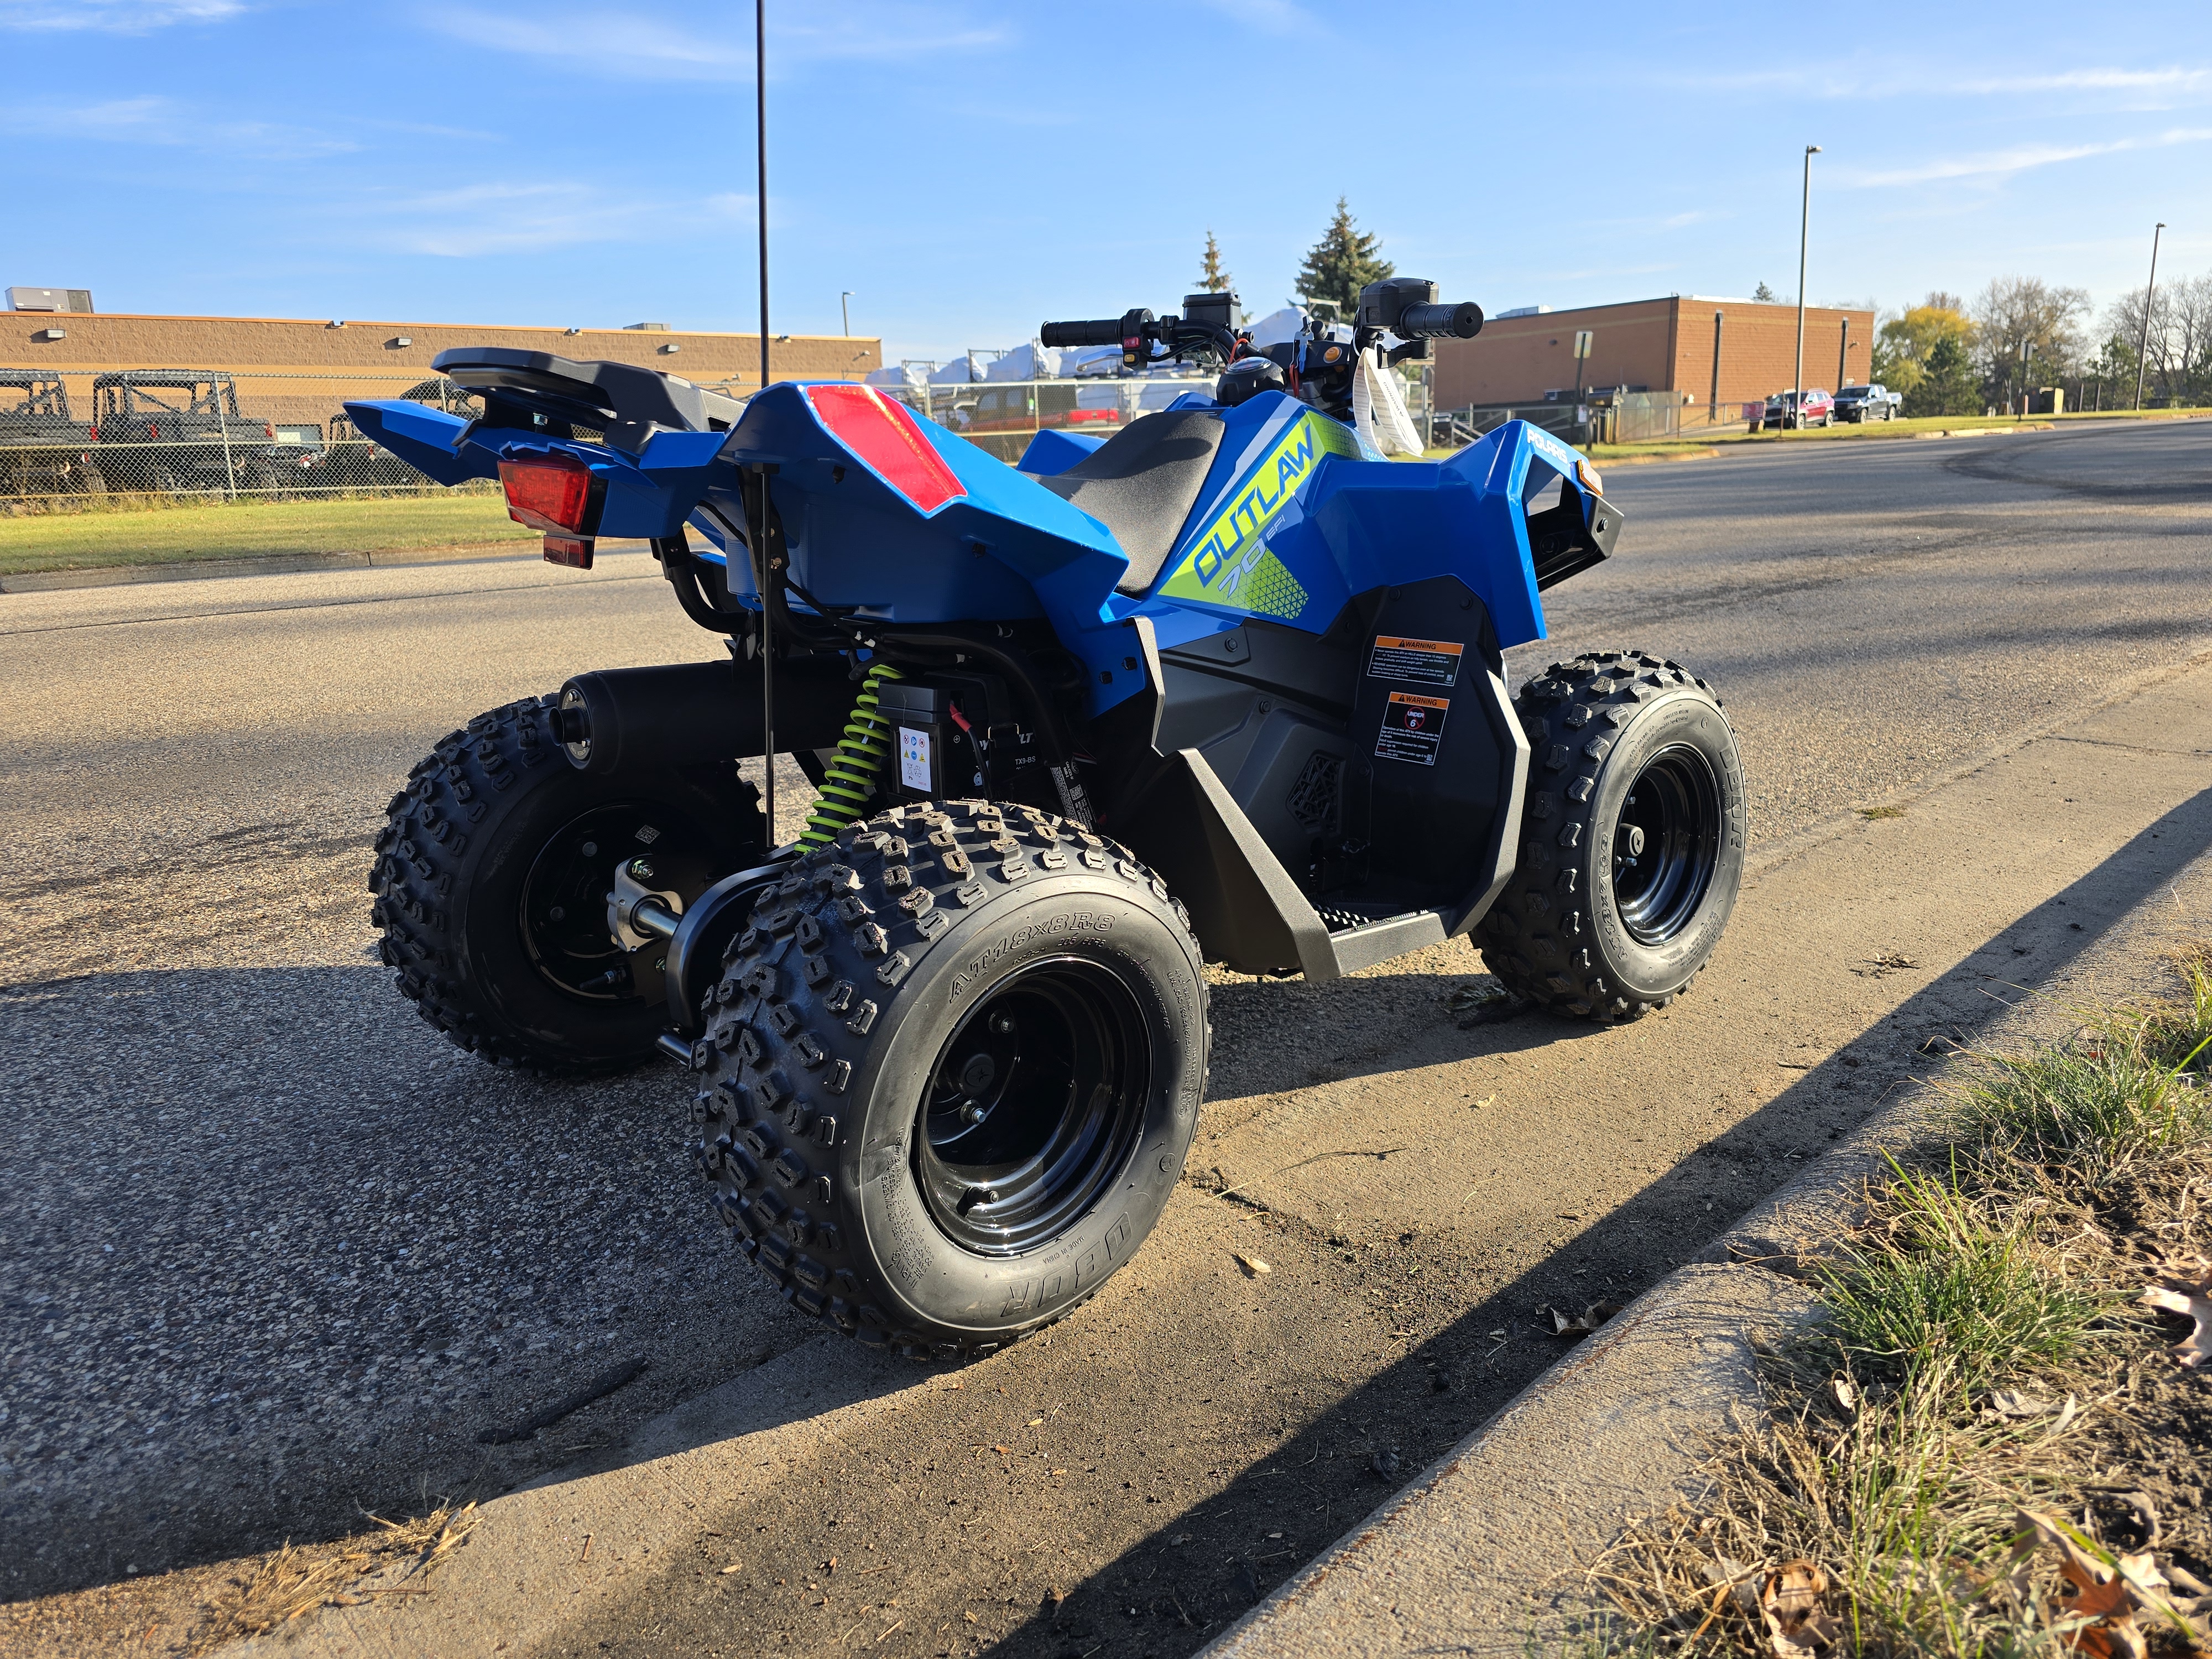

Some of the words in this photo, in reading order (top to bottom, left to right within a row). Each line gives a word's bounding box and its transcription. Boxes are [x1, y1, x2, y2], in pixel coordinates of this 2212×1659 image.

[1527, 428, 1568, 465] POLARIS
[1193, 424, 1314, 588] OUTLAW
[1217, 540, 1267, 598] 70
[1266, 515, 1286, 541] EFI
[1405, 641, 1436, 650] WARNING
[1406, 696, 1437, 706] WARNING
[950, 912, 1115, 1004] AT18x8R8
[881, 1176, 891, 1209] OWNER'S
[1043, 1253, 1060, 1264] CHINA
[1068, 1235, 1085, 1250] MADE
